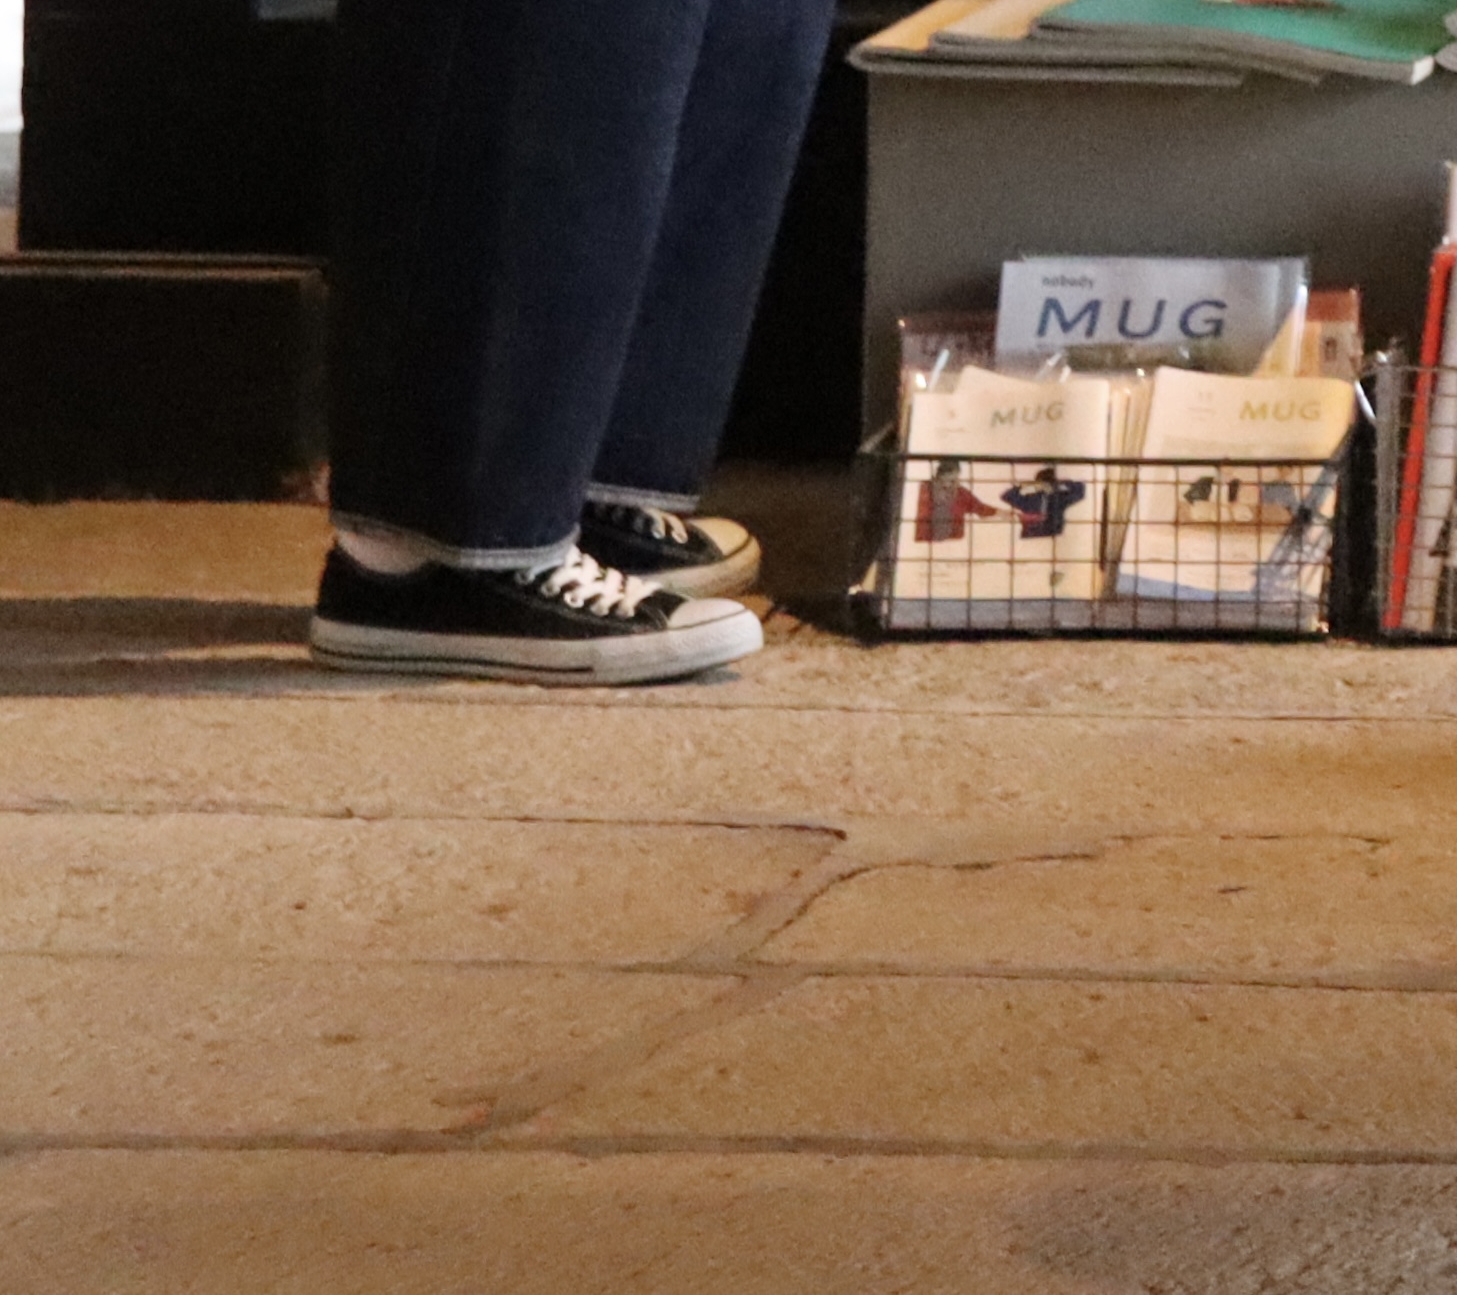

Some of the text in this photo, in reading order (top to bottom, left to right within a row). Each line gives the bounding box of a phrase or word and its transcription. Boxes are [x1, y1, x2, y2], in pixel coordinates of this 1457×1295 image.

[1035, 297, 1229, 341] MUG
[989, 400, 1065, 428] MUG
[1238, 399, 1324, 423] MUG
